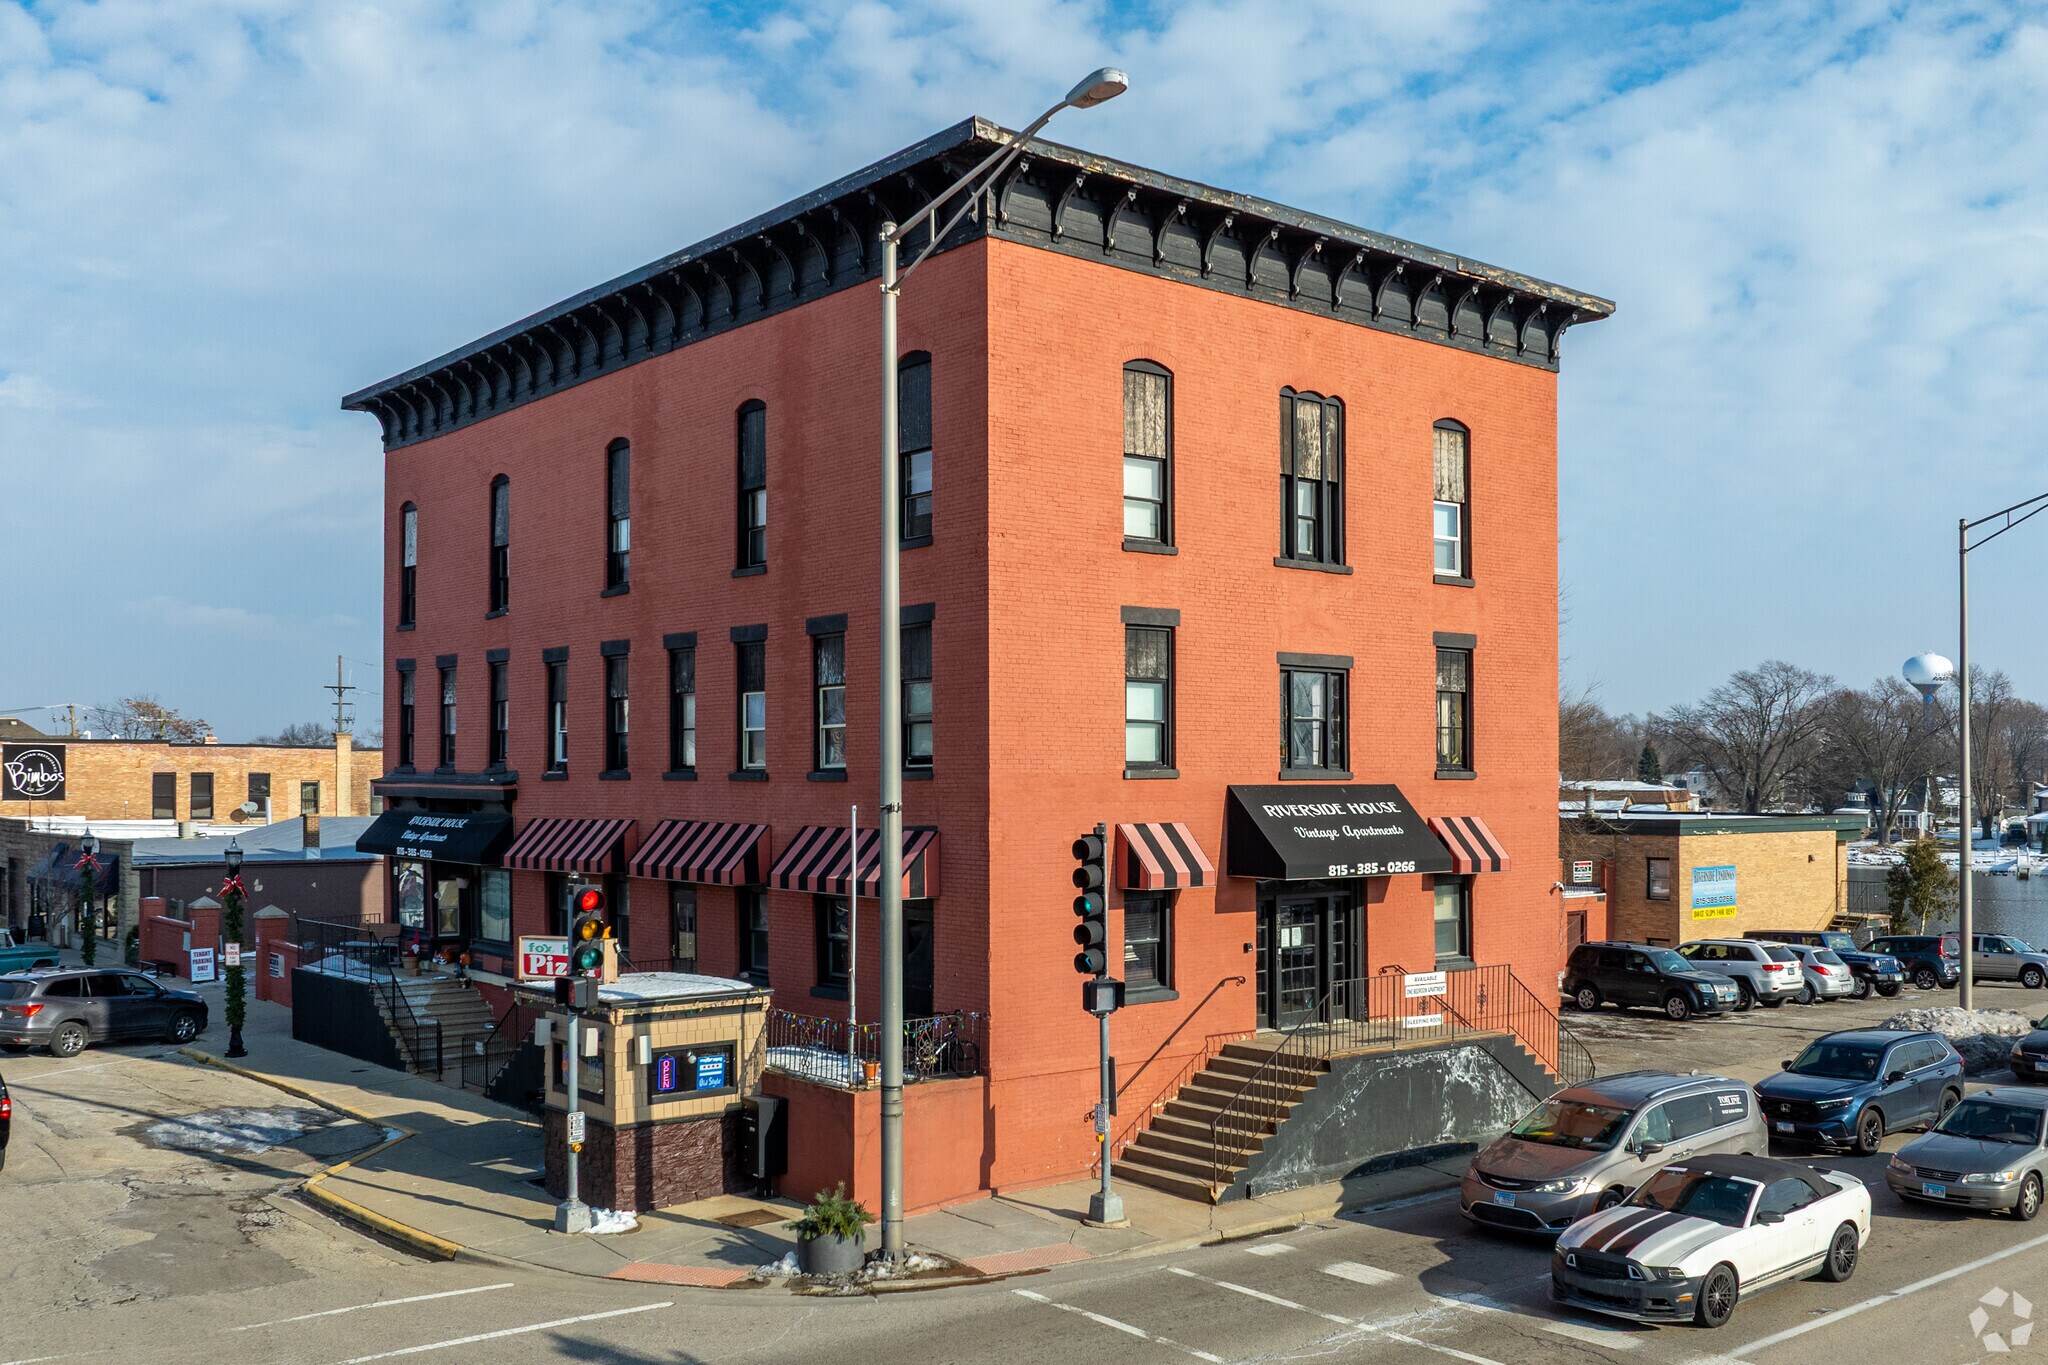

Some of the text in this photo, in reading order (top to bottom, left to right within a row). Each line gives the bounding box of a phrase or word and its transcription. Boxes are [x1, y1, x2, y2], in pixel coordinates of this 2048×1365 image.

[4, 762, 65, 790] Bimbos
[1262, 801, 1402, 819] RIVERSIDE HOUSE
[408, 815, 470, 829] RIVERSIDE HOUSE
[401, 829, 449, 843] Vintage Apartments
[1293, 824, 1404, 841] Vintage Apartments
[1693, 868, 1735, 884] RIVERSIDE LANDINGS
[192, 957, 213, 965] PARKING
[193, 950, 211, 958] TENANT
[1407, 1017, 1429, 1026] SLEEPING
[662, 1060, 671, 1088] OPEN
